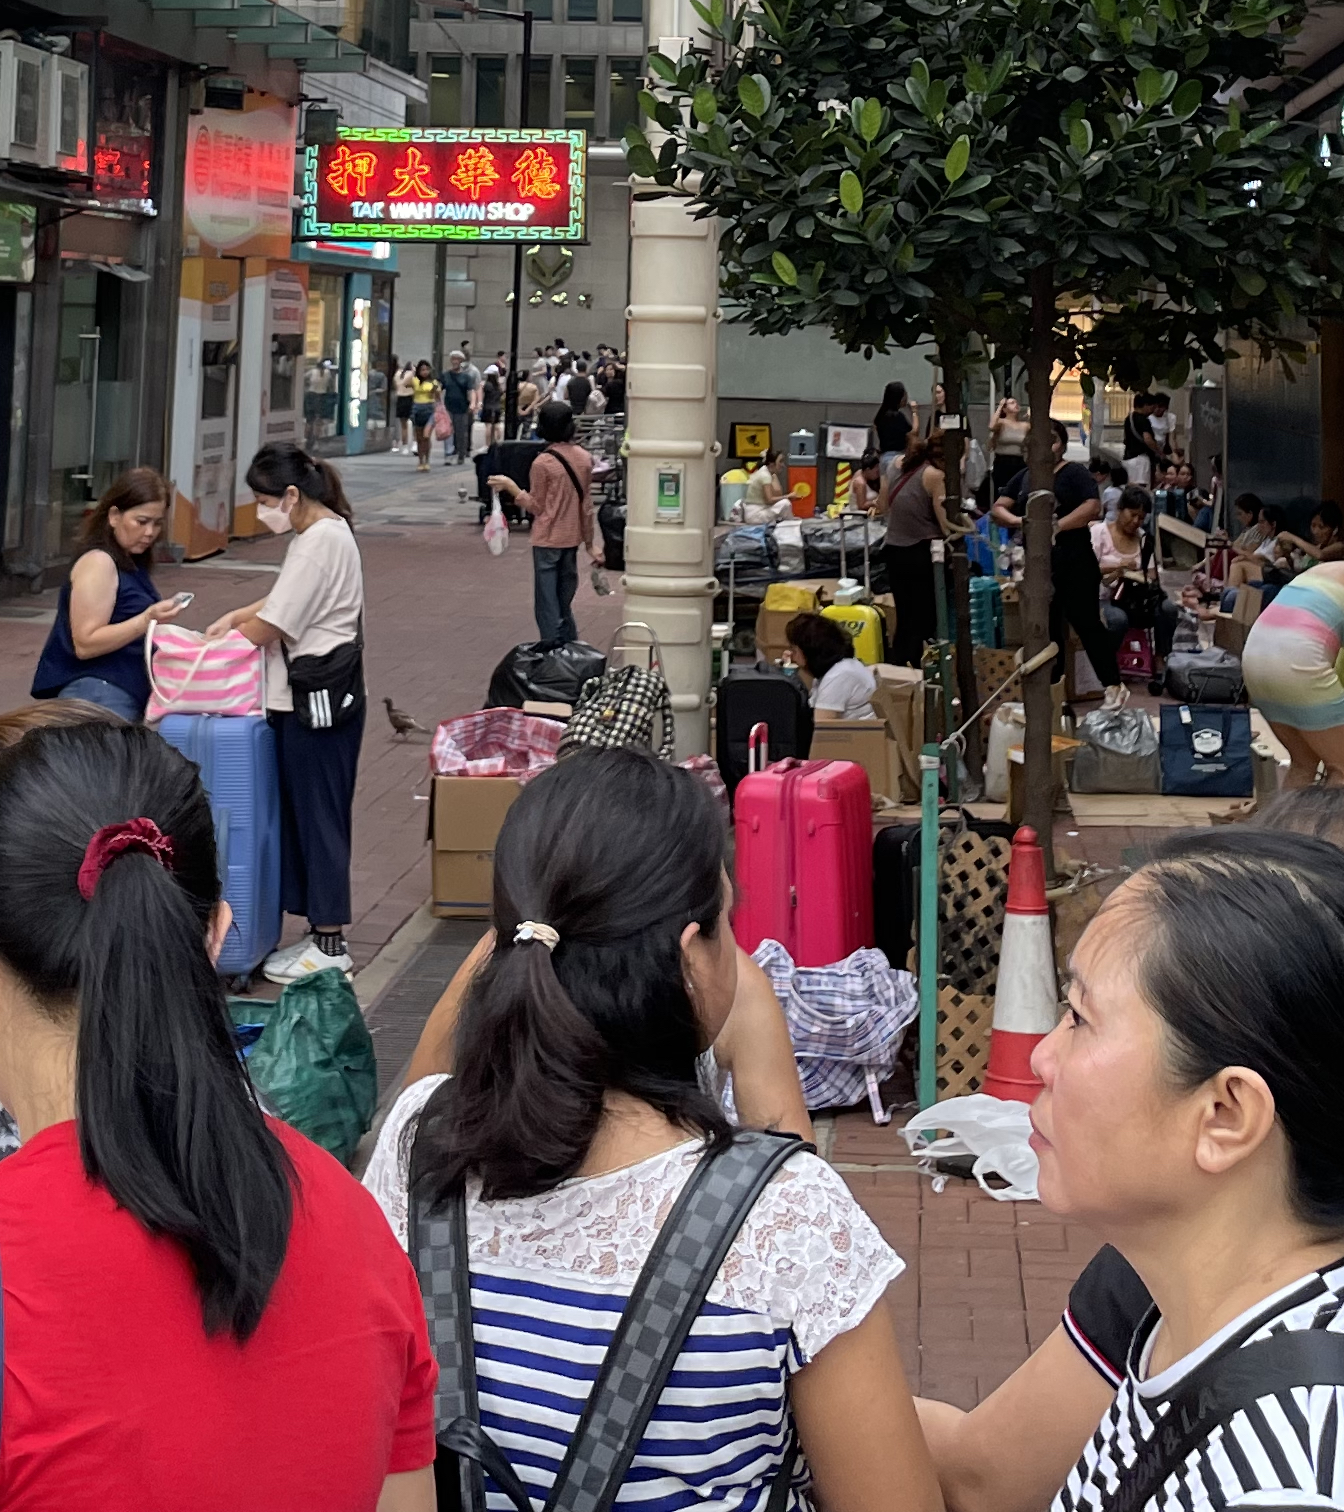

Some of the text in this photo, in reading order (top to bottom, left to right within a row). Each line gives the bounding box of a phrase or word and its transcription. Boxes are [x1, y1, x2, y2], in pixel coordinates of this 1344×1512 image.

[389, 201, 432, 221] WAH
[434, 202, 485, 221] PAWN
[486, 201, 536, 222] SHOP
